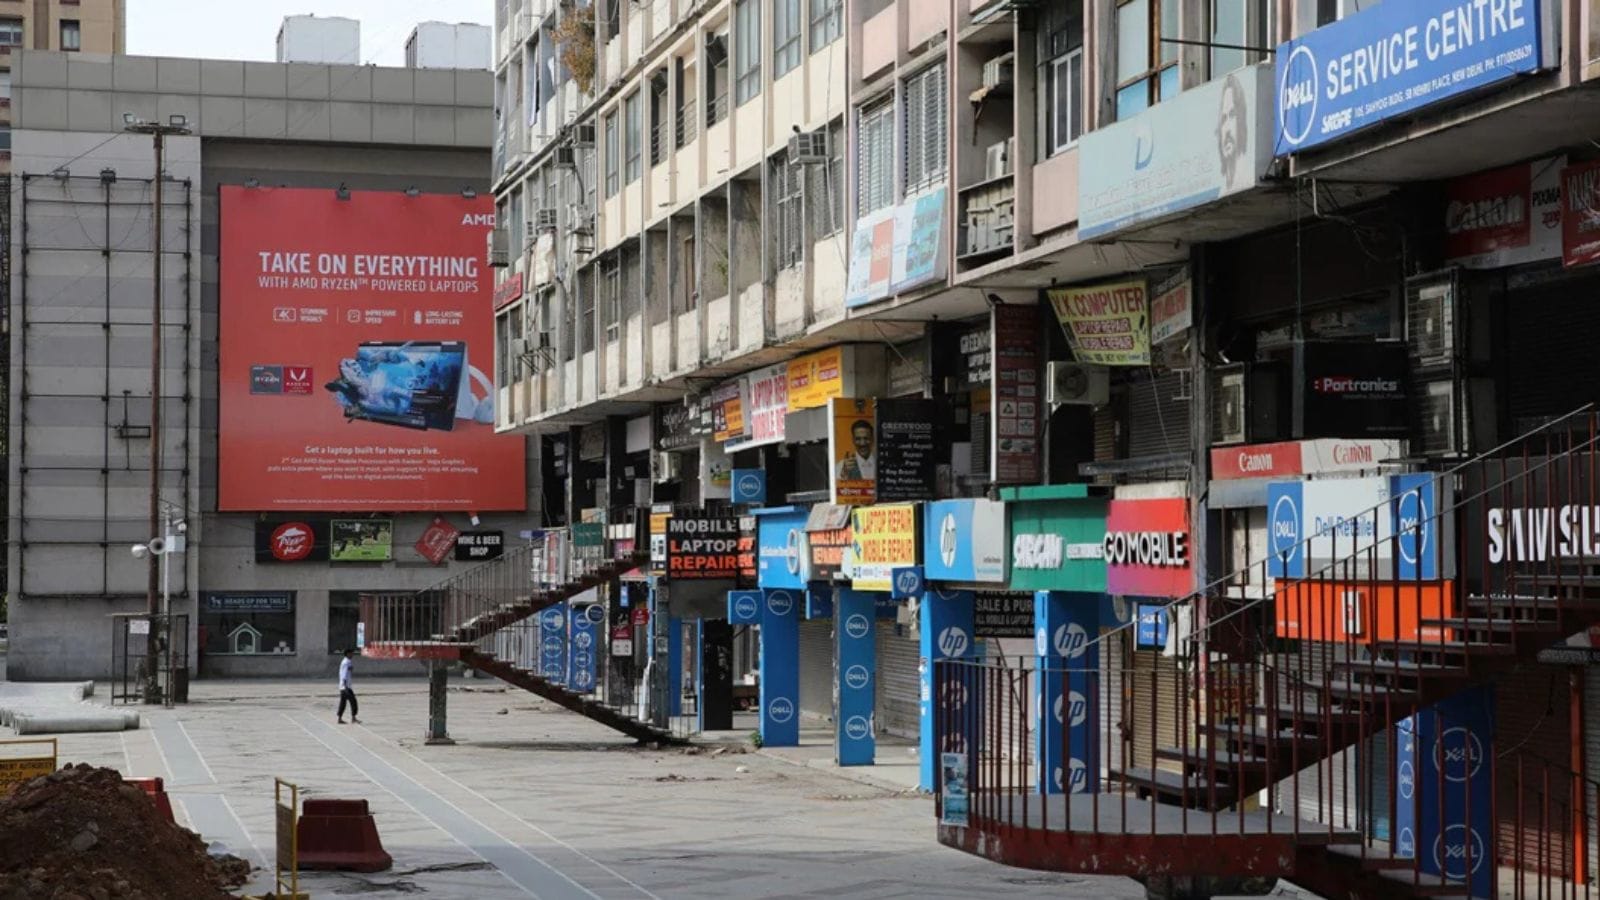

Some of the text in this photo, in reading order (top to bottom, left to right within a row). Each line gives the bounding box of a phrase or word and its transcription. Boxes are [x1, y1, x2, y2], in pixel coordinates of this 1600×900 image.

[1326, 0, 1525, 99] SERVICE CENTRE
[1451, 68, 1465, 82] NEW
[1284, 80, 1314, 112] DELL
[1446, 194, 1525, 234] Canon
[259, 251, 478, 277] TAKE ON EVERYTHING
[259, 276, 288, 288] WITH
[292, 277, 317, 289] AMD
[371, 279, 426, 292] POWERED
[430, 280, 479, 293] LAPTOPS
[1074, 287, 1145, 317] COMPUTER
[279, 310, 290, 319] 4K
[1323, 377, 1397, 392] Portronics
[881, 422, 932, 430] GREENWOOD
[305, 446, 319, 454] Get
[327, 446, 353, 456] laptop
[355, 446, 373, 455] built
[375, 446, 387, 455] for
[389, 446, 405, 455] how
[407, 448, 422, 457] you
[423, 447, 440, 455] live.
[1333, 444, 1373, 465] Canon
[1238, 452, 1273, 472] Canon
[363, 474, 382, 482] digital
[669, 519, 737, 533] MOBILE
[863, 508, 912, 534] LAPTOP REPAIR
[1275, 521, 1295, 537] DELL
[1315, 516, 1333, 536] Dell
[458, 536, 475, 544] WINE
[483, 535, 500, 544] BEER
[669, 539, 737, 553] LAPTOP
[942, 512, 956, 568] hp
[1103, 531, 1185, 566] GOMOBILE
[470, 547, 488, 556] SHOP
[863, 539, 886, 562] MOBILE
[888, 539, 912, 562] REPAIR
[669, 555, 737, 570] REPAIR
[898, 571, 918, 593] hp
[976, 599, 1001, 612] SALE
[1002, 599, 1011, 611] &
[941, 626, 966, 657] hp
[1056, 622, 1086, 659] hp
